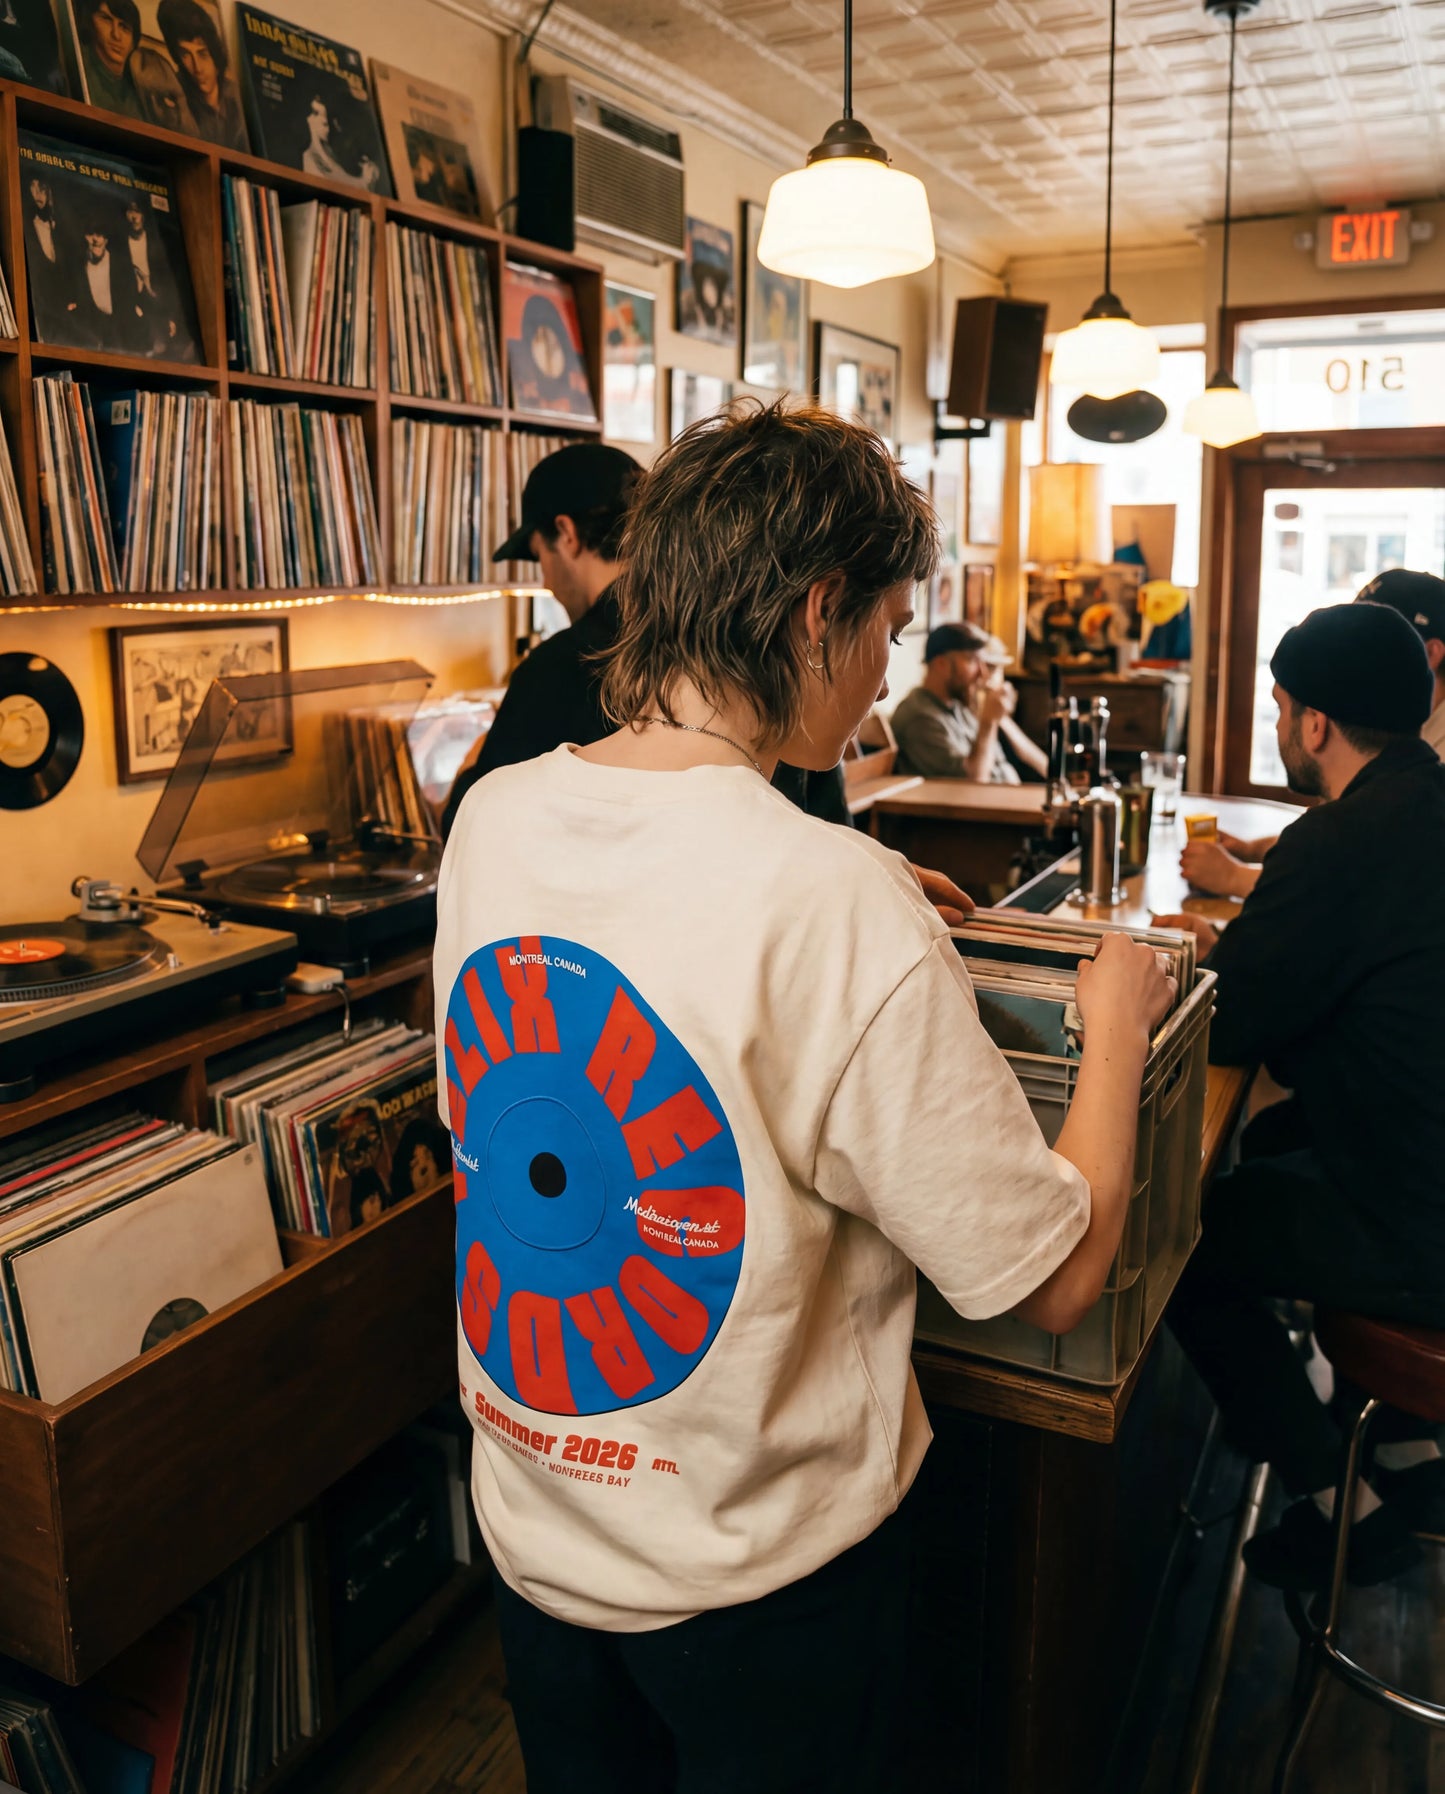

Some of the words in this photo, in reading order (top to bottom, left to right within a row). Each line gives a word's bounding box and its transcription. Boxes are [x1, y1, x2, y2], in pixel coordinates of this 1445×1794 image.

[1331, 211, 1400, 263] EXIT
[508, 954, 553, 966] MONTREAL
[553, 956, 587, 979] CANADA
[682, 1237, 719, 1249] CANADA
[475, 1391, 558, 1456] Summer
[561, 1434, 639, 1471] 2026
[606, 1474, 631, 1488] BAY
